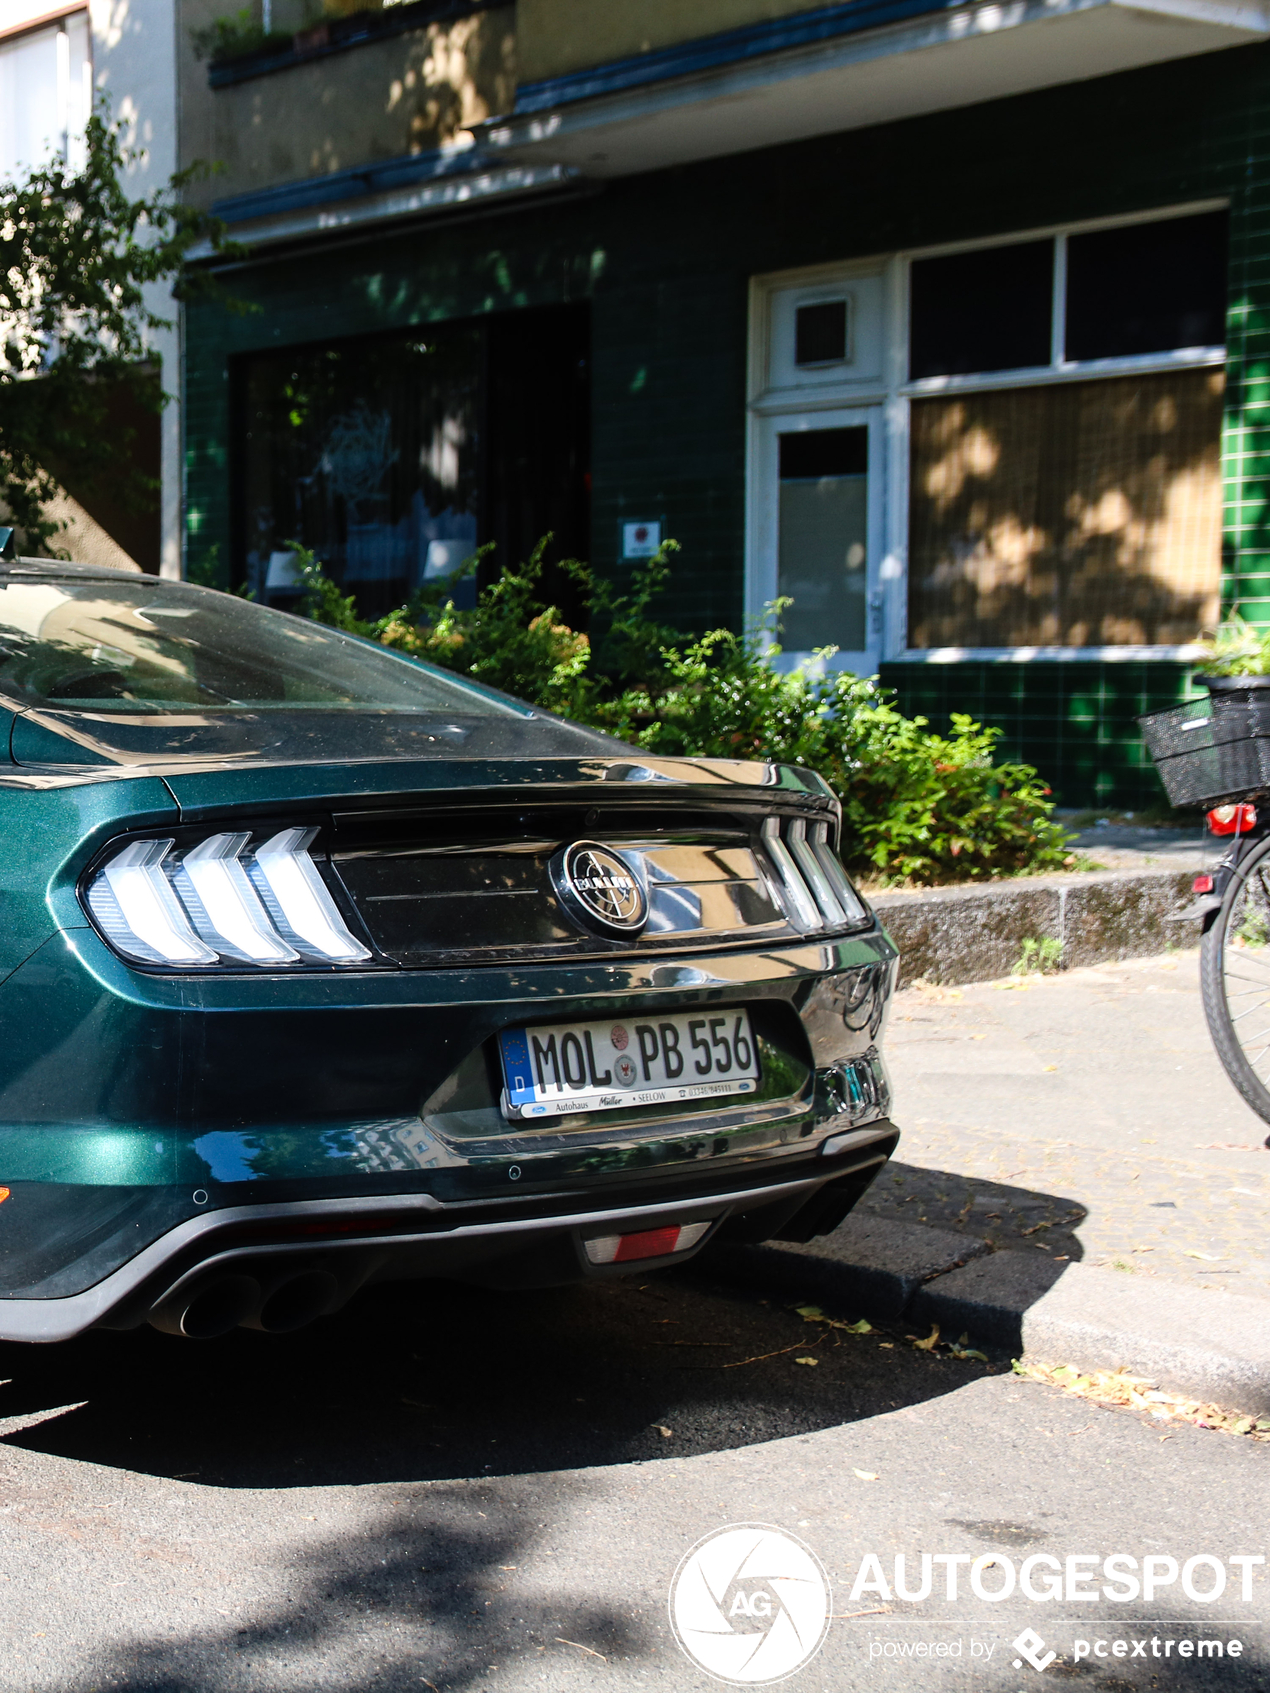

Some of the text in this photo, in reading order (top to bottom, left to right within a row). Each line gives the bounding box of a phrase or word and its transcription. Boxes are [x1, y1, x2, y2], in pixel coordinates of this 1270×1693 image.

[531, 1016, 753, 1094] MOL PB 556
[514, 1075, 526, 1093] D
[556, 1101, 589, 1112] Autohaus
[638, 1091, 667, 1103] SEELOW
